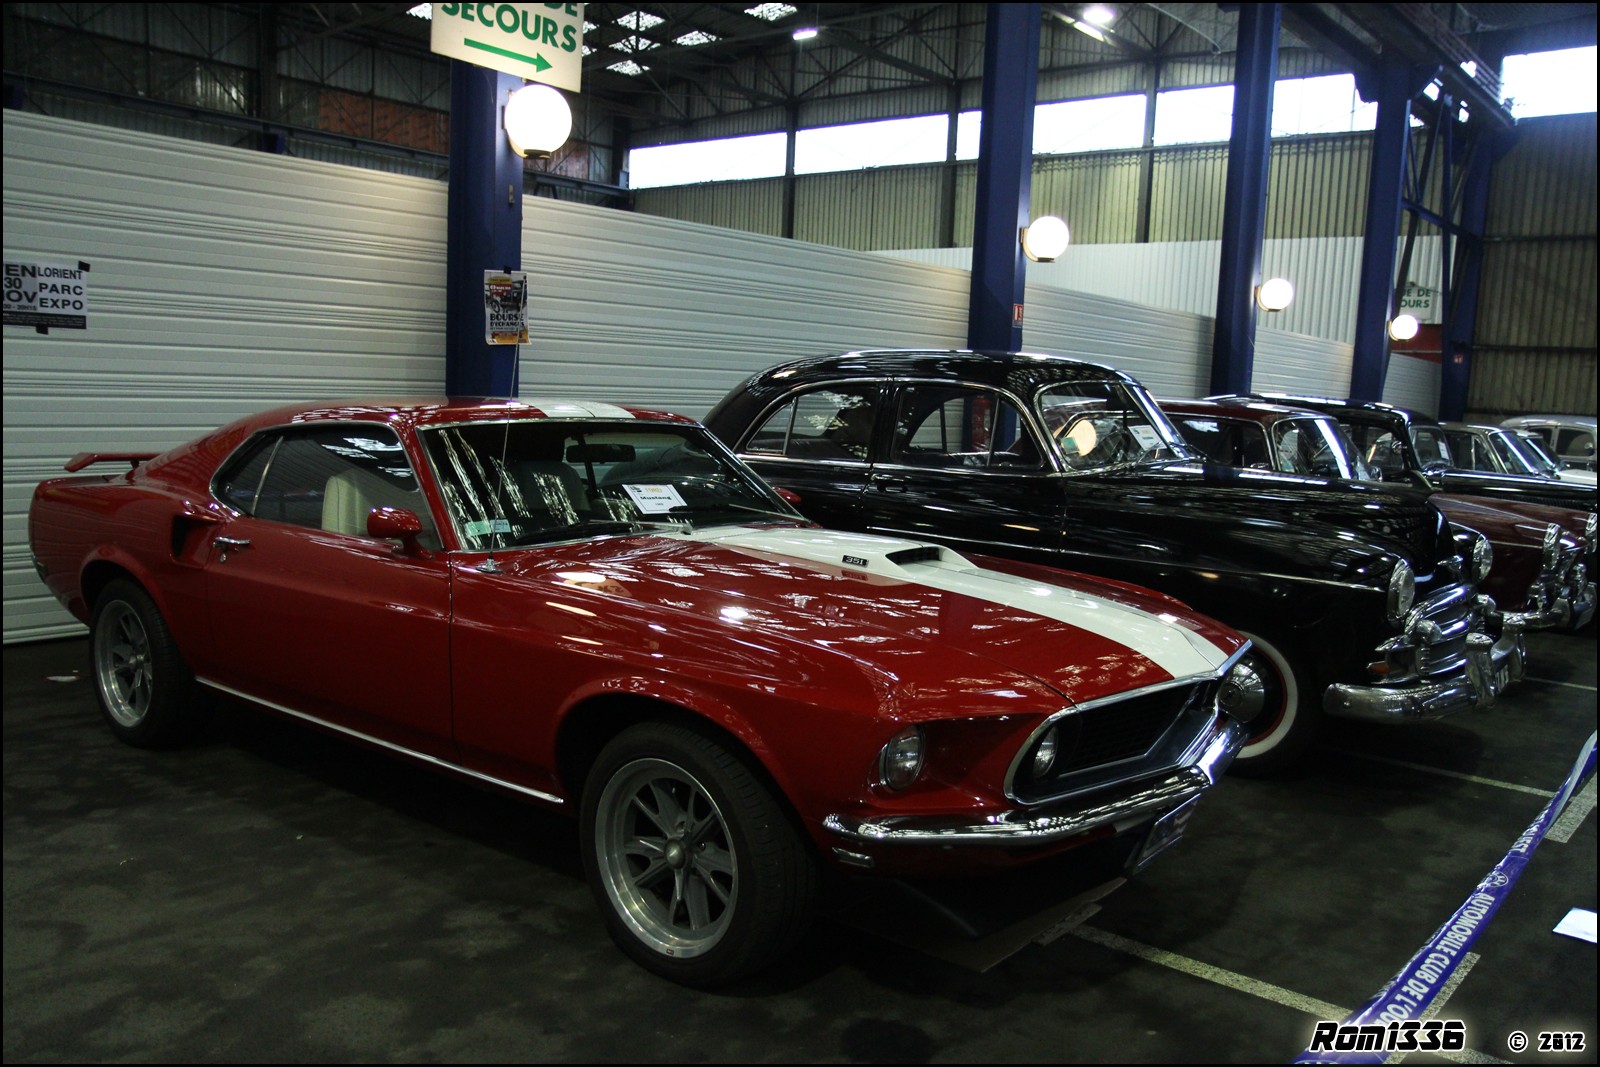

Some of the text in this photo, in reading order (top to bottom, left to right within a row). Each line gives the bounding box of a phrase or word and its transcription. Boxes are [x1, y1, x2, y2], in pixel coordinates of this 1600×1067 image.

[4, 264, 37, 278] EN
[37, 266, 83, 280] LORIENT
[4, 277, 22, 289] 30
[38, 283, 83, 296] PARC
[3, 290, 37, 303] OV
[1417, 288, 1431, 297] DE
[39, 298, 83, 310] EXPO
[490, 313, 524, 321] BOURSE
[845, 556, 864, 565] 351
[1435, 892, 1495, 957] AUTOMOBILE
[1414, 953, 1450, 988] CLUB
[1401, 978, 1430, 1001] DE
